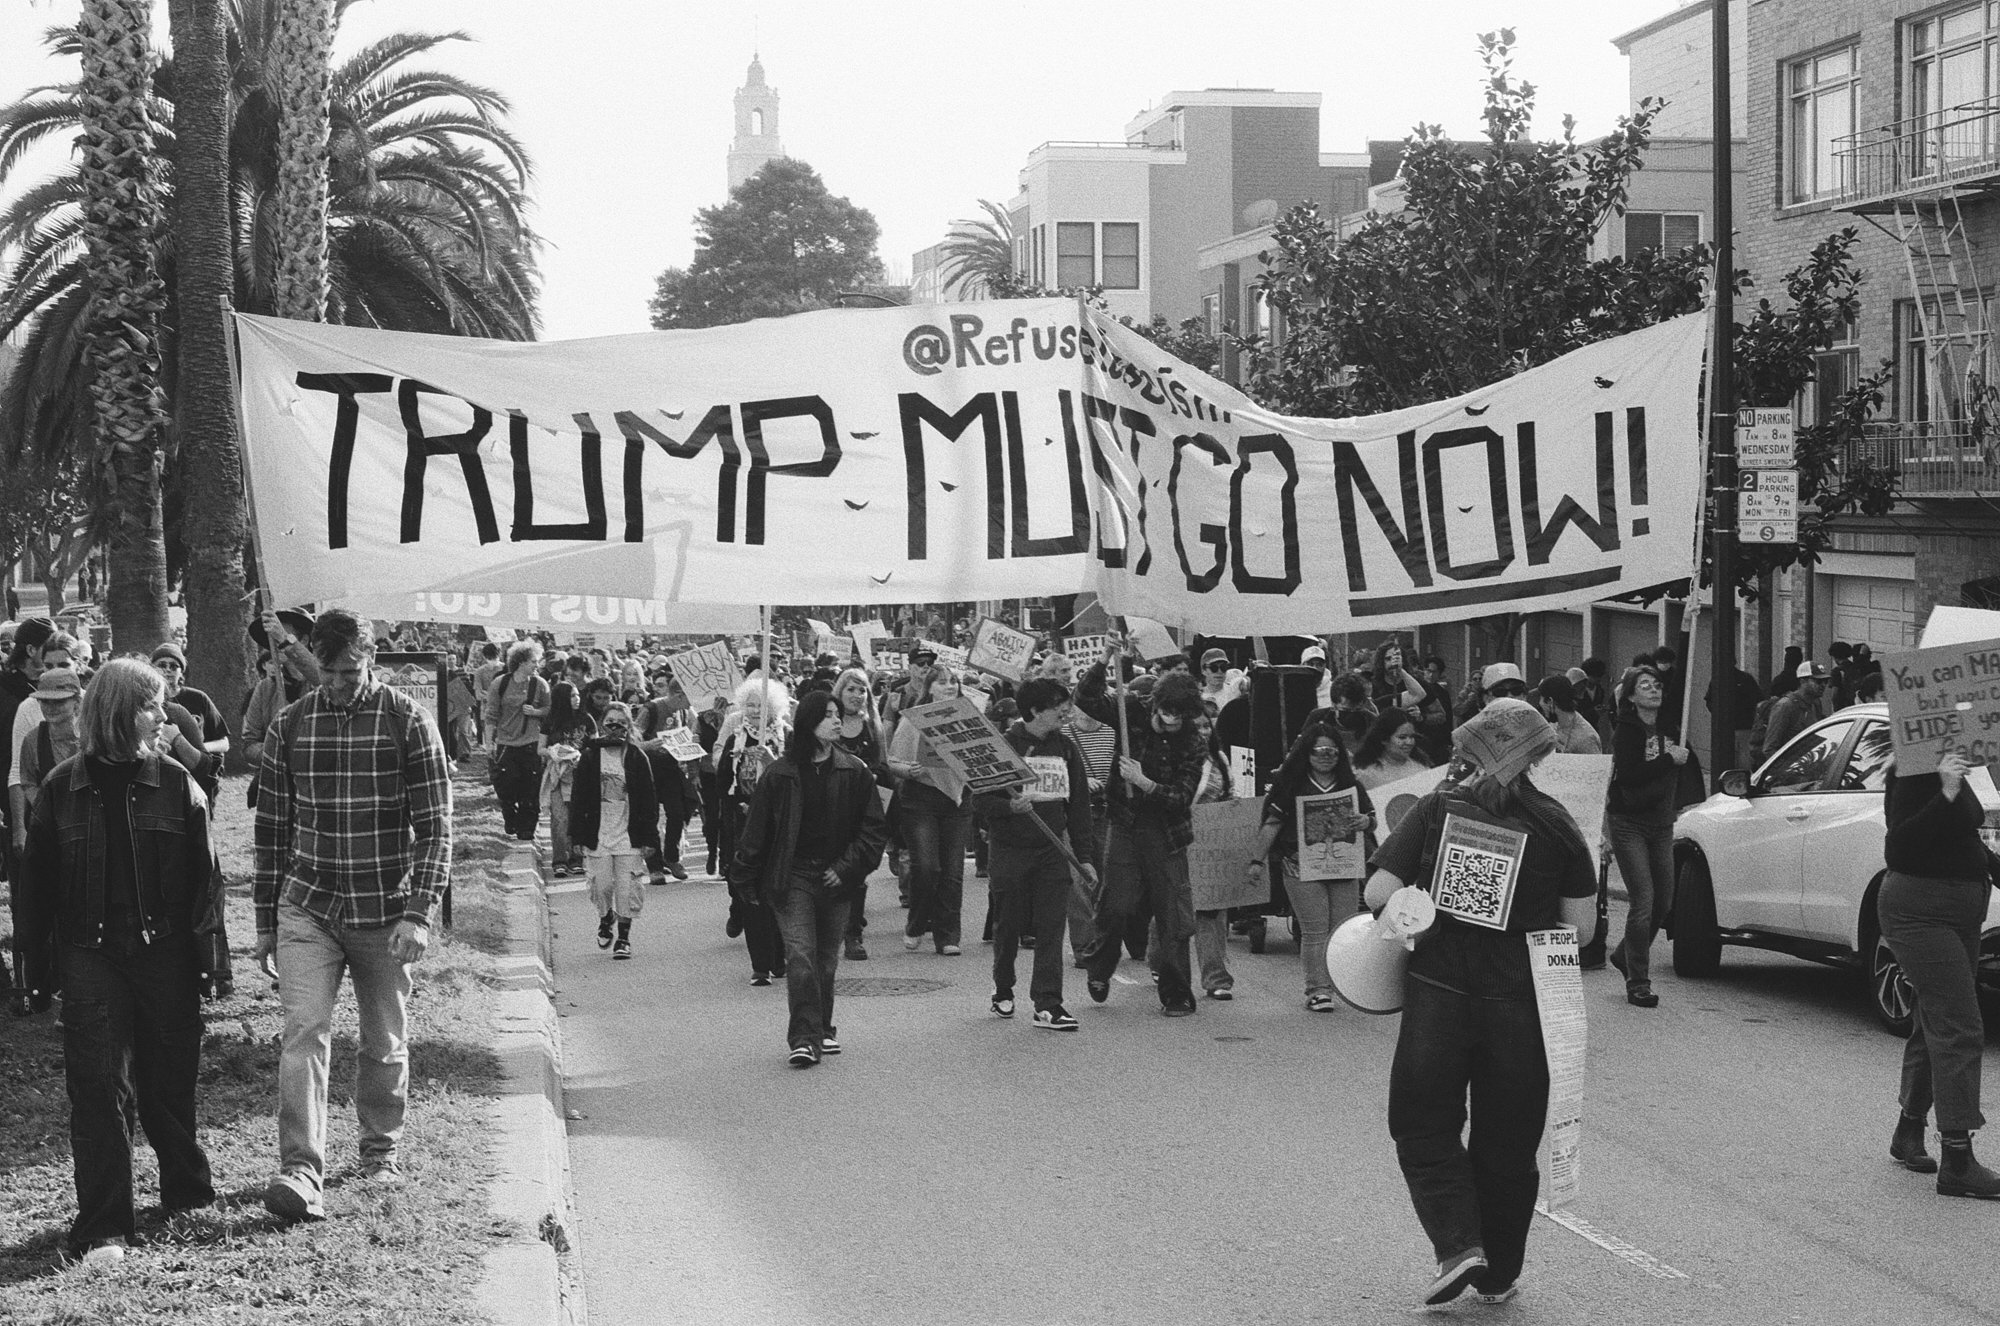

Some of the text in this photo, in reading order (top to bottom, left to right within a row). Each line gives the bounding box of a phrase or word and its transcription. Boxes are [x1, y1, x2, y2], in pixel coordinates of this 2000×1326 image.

[1740, 410, 1791, 426] NO PARKING
[1741, 444, 1790, 455] WEDNESDAY
[296, 371, 1650, 597] TRUMP MUST GO NOW!
[1743, 473, 1789, 489] 2 HOUR
[1759, 484, 1796, 493] PARKING
[1745, 508, 1762, 517] MON
[1779, 508, 1791, 517] FRI
[1762, 527, 1773, 539] S
[990, 631, 1029, 650] ABOLISH
[995, 647, 1013, 662] ICE
[671, 645, 735, 688] ABOLISH
[1891, 665, 1925, 691] You
[1932, 665, 1963, 684] can
[1917, 689, 1949, 711] but
[1905, 713, 1962, 741] HIDE
[951, 749, 969, 760] THE
[965, 742, 998, 757] PEOPLE
[1531, 933, 1547, 947] THE
